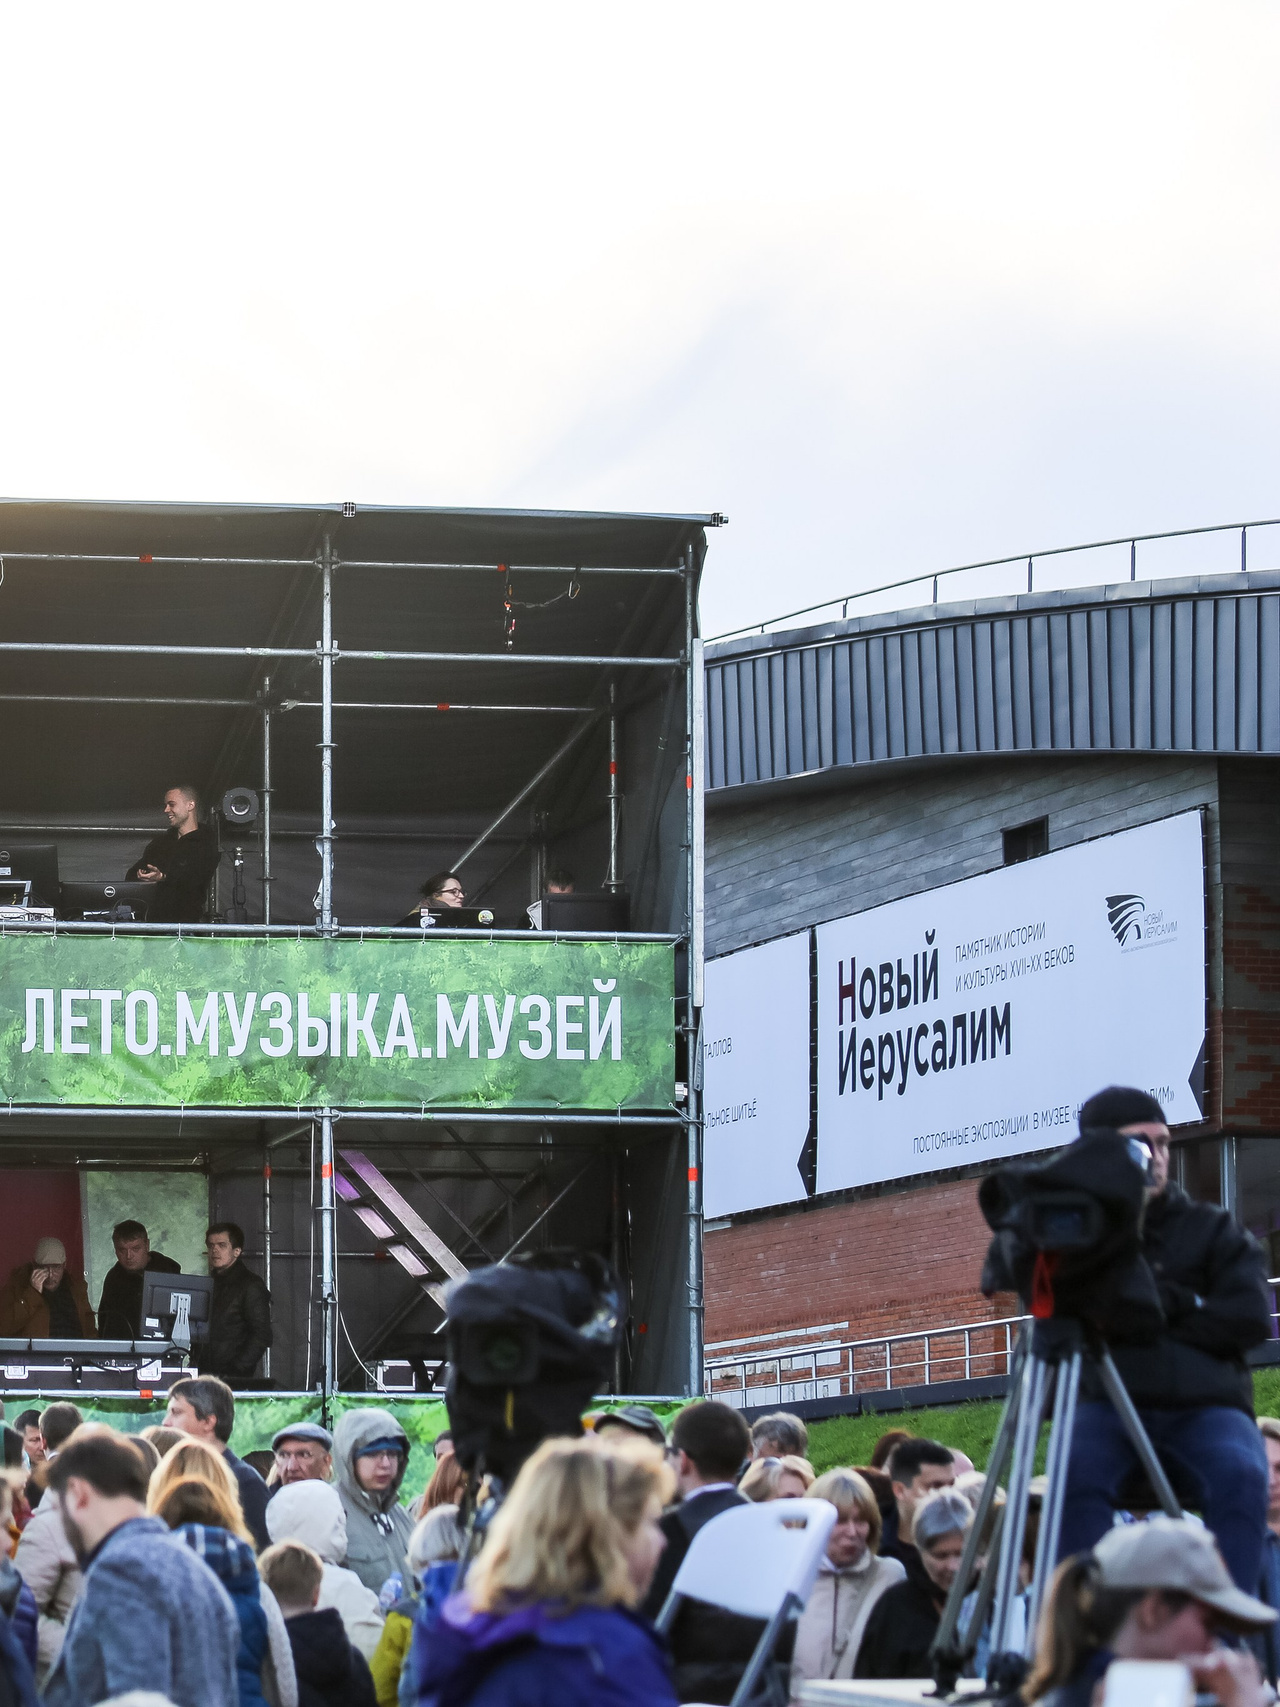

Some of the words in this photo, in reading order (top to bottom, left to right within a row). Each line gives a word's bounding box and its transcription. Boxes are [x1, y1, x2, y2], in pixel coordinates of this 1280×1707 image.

[954, 933, 1003, 963] ПАМЯТНИК
[1003, 921, 1047, 950] ИСТОРИИ
[838, 928, 939, 1026] Новый
[955, 975, 962, 993] И
[963, 962, 1008, 991] КУЛЬТУРЫ
[1044, 944, 1075, 970] ВЕКОВ
[21, 977, 622, 1060] ЛЕТО.МУЗЫКА.МУЗЕЙ
[838, 1001, 1012, 1102] Иерусалим
[703, 1107, 730, 1129] ЛЬНОЕ
[913, 1126, 969, 1154] ПОСТОЯННЫЕ
[971, 1114, 1029, 1143] ЭКСПОЗИЦИИ
[1033, 1112, 1040, 1130] В
[1041, 1105, 1070, 1129] МУЗЕЕ
